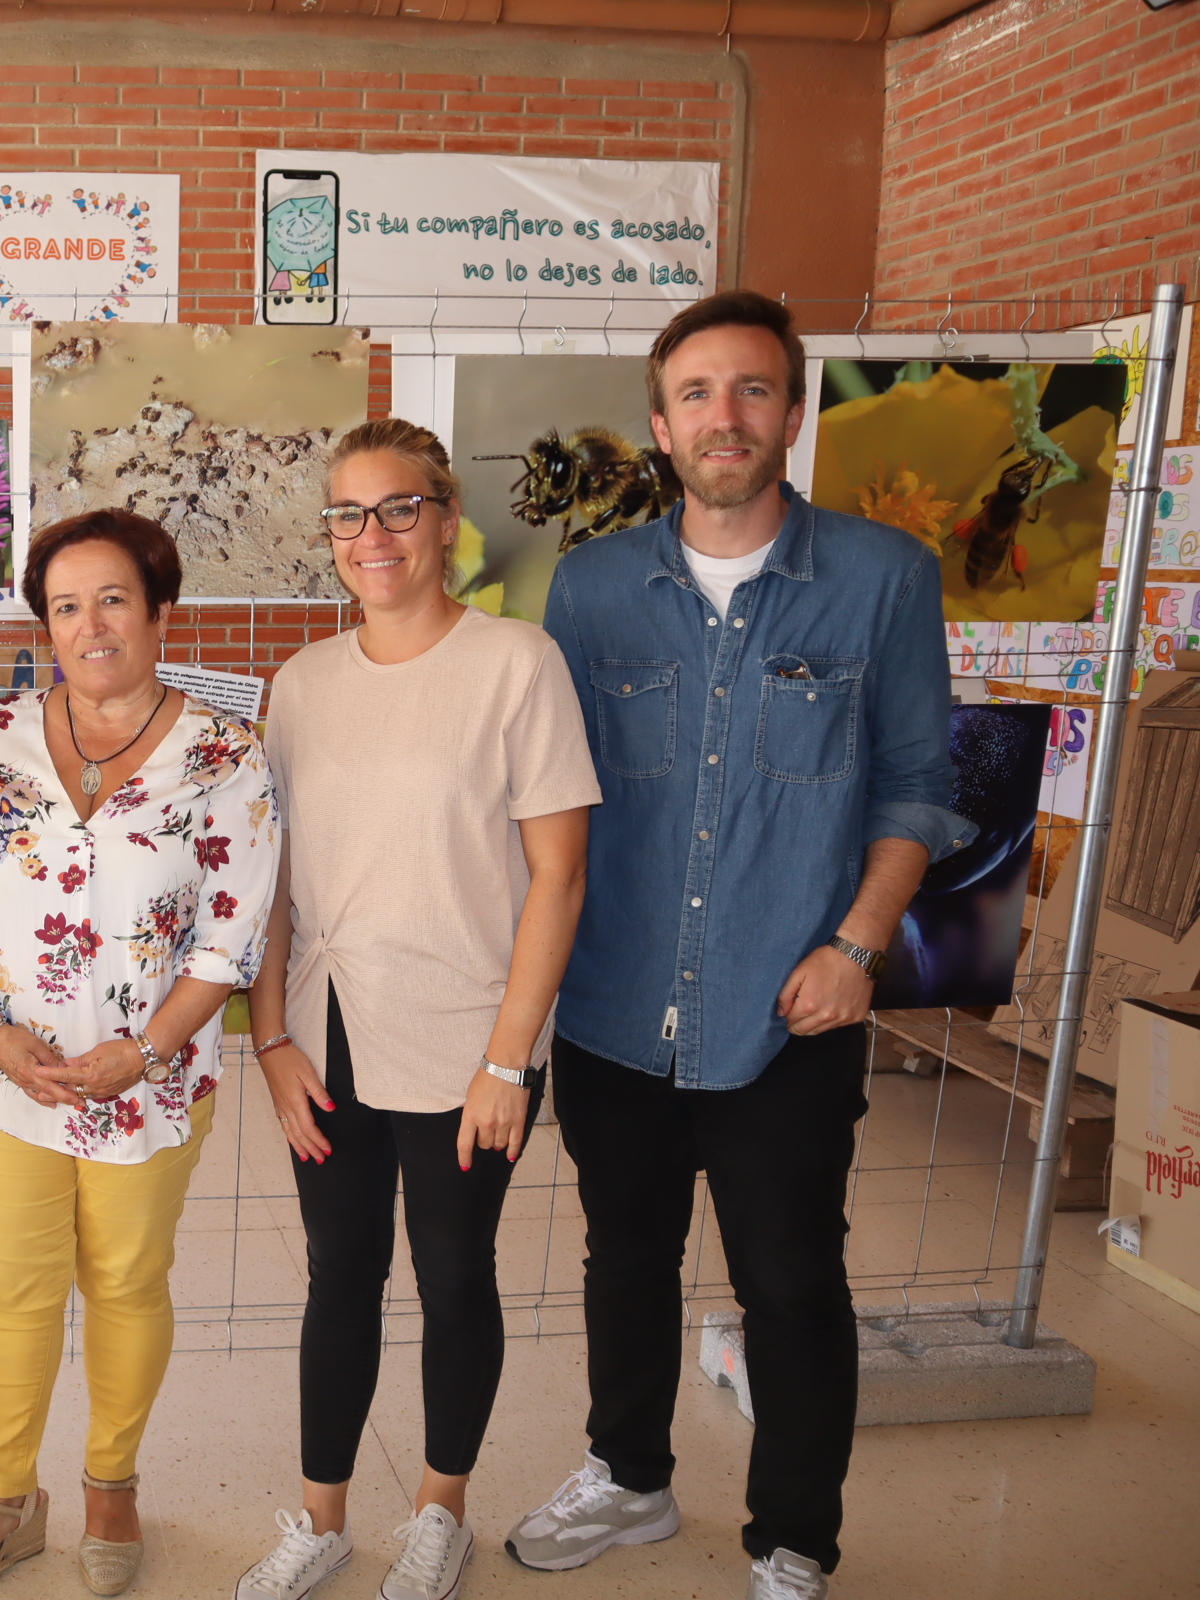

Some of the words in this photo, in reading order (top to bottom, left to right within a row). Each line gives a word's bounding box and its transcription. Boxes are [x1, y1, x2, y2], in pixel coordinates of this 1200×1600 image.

[345, 210, 370, 234] Si
[377, 212, 409, 236] tu
[417, 209, 564, 241] compañero
[574, 214, 600, 239] es
[610, 218, 712, 249] acosado,
[0, 237, 126, 261] GRANDE
[463, 262, 494, 281] no
[506, 258, 527, 282] lo
[539, 258, 601, 287] dejes
[611, 260, 638, 283] de
[649, 262, 704, 286] lado.
[1146, 1145, 1200, 1199] erfield
